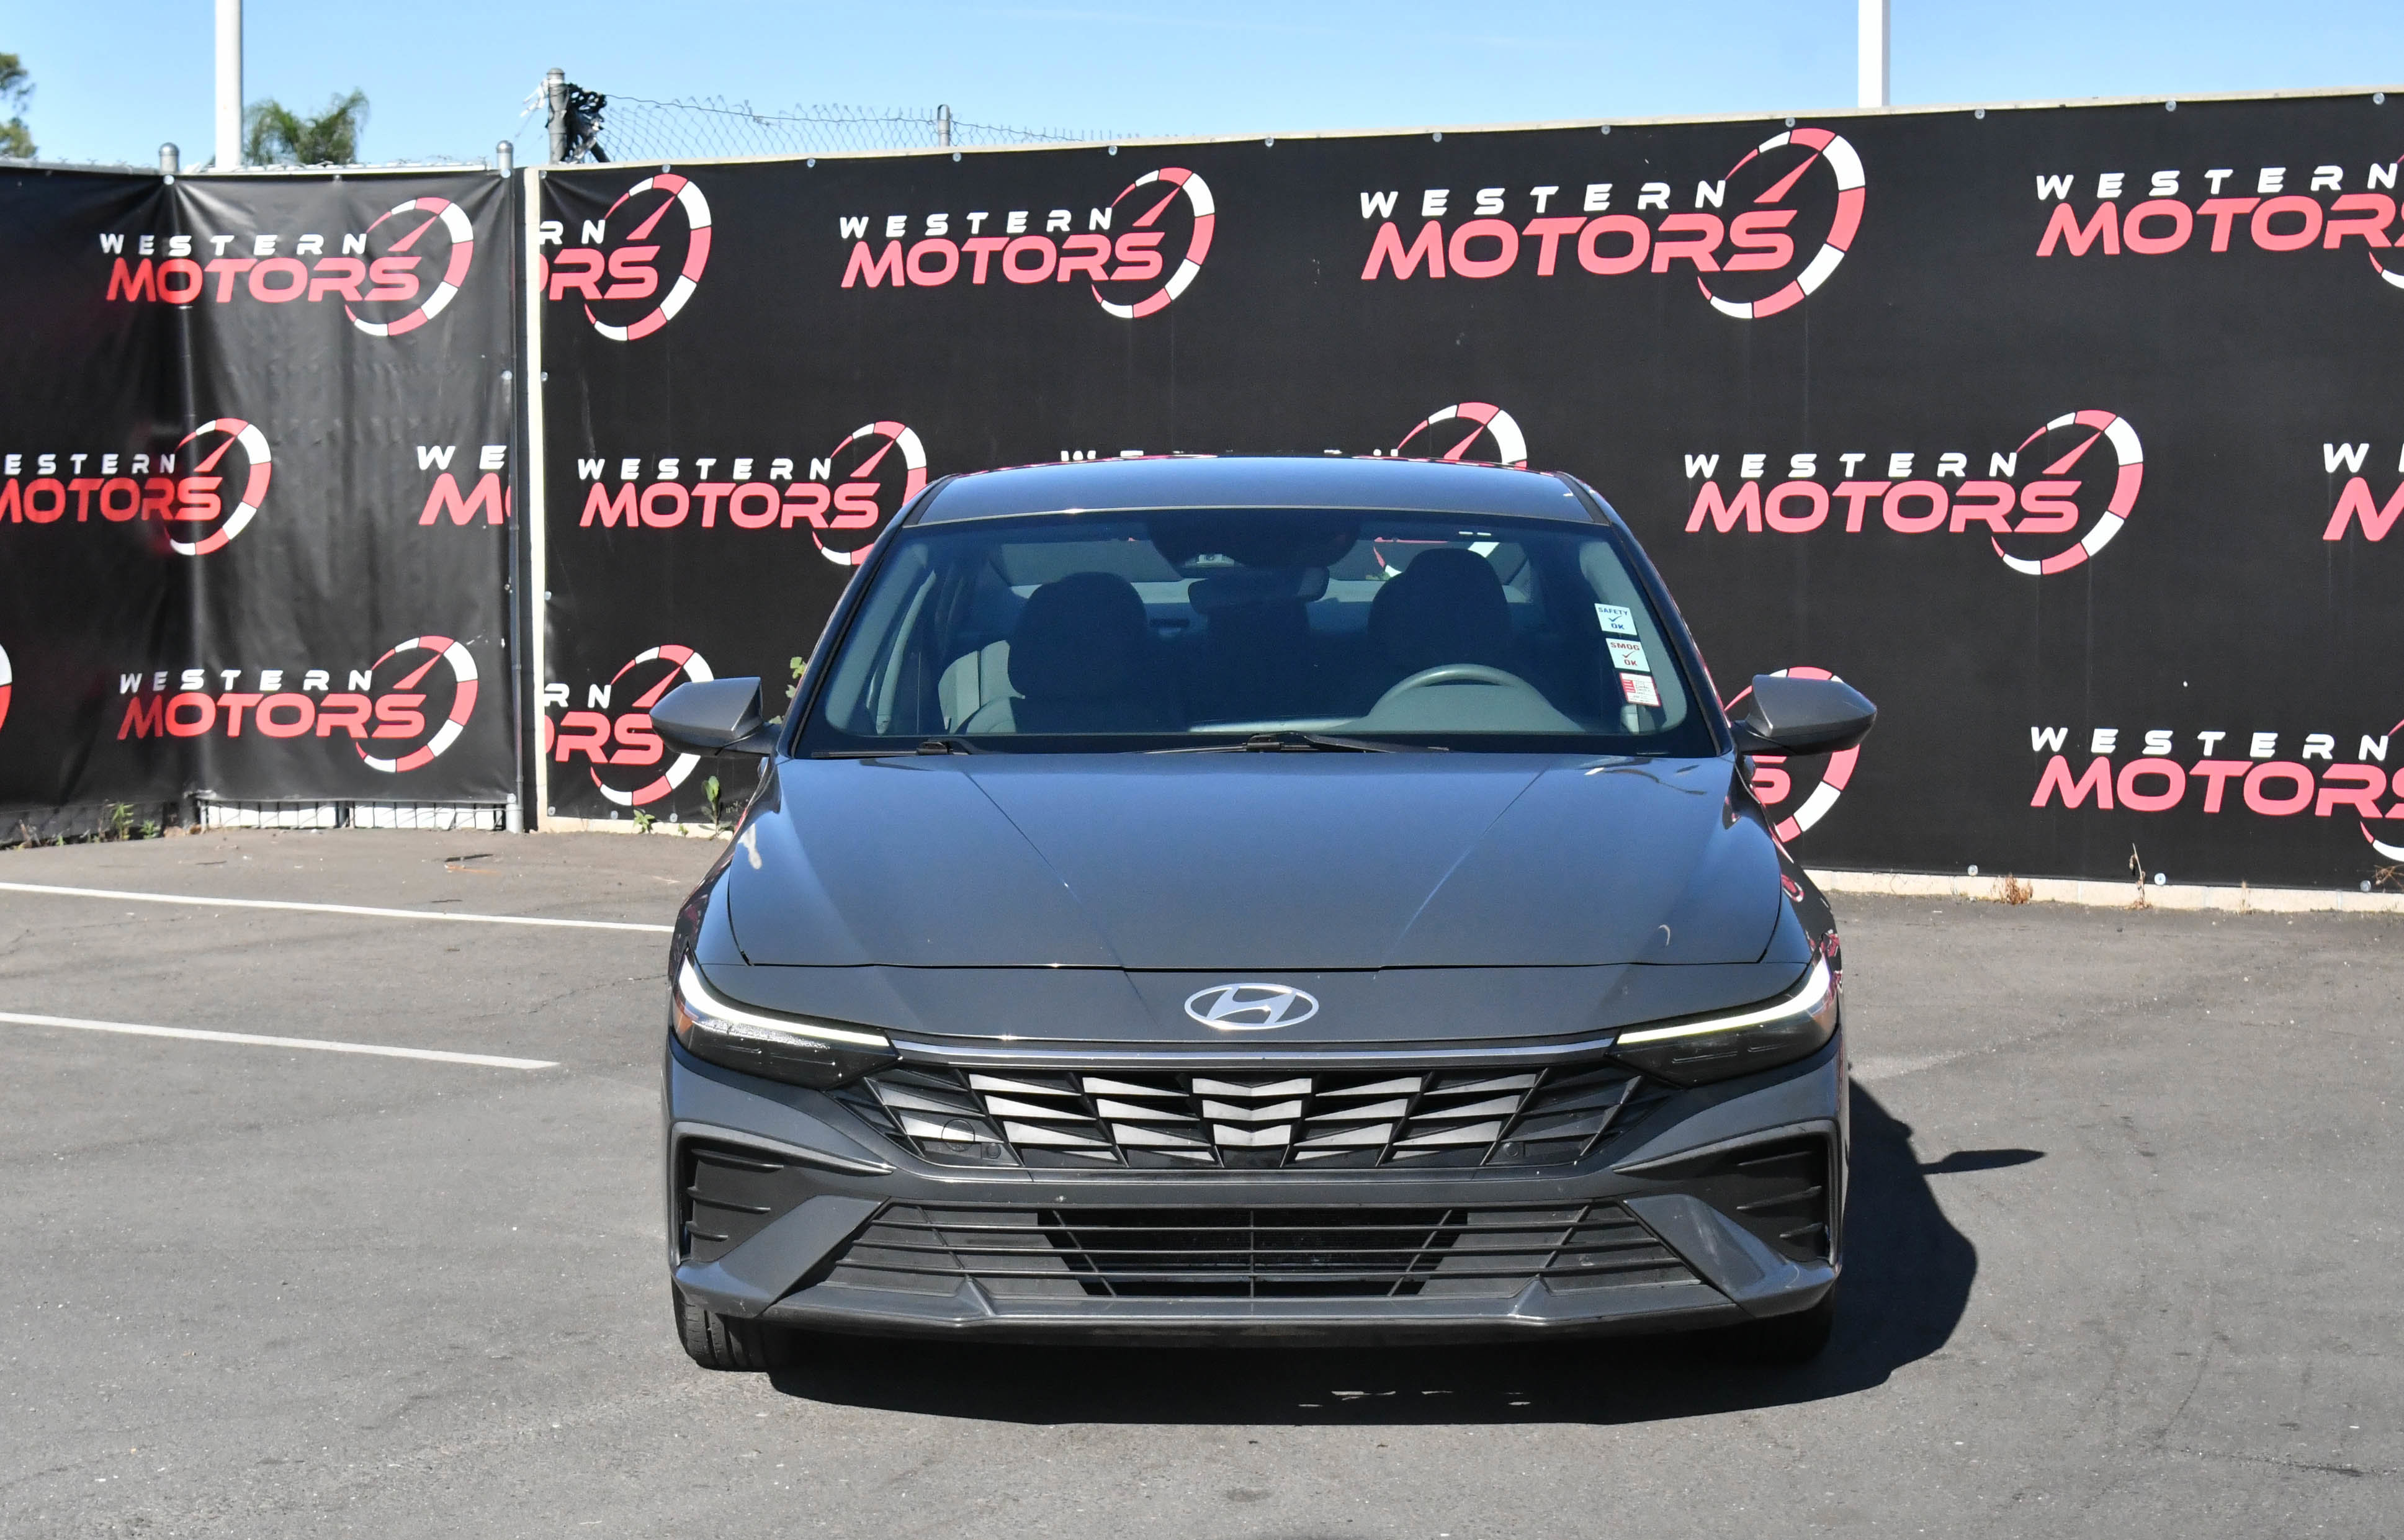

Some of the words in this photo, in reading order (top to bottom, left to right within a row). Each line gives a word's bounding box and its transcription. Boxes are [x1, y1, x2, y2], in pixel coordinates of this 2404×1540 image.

[1360, 179, 1726, 218] WESTERN
[2036, 163, 2398, 200] WESTERN
[840, 207, 1113, 240] WESTERN
[2036, 193, 2404, 256] MOTOR
[100, 233, 367, 256] WESTERN
[841, 232, 1165, 288] MOTORS
[1361, 210, 1798, 280] MOTORS
[106, 256, 421, 304] MOTORS
[540, 245, 660, 300] RS
[4, 454, 176, 475] ESTERN
[578, 458, 832, 480] WESTERN
[1684, 452, 2017, 478] WESTERN
[579, 482, 881, 529] MOTORS
[1685, 480, 2082, 534] MOTORS
[1598, 607, 1628, 616] SAFETY
[1610, 642, 1639, 651] SMOG
[119, 669, 372, 694] WESTERN
[117, 692, 426, 740] MOTORS
[544, 711, 664, 765] RS
[2031, 727, 2389, 761] WESTERN
[2030, 754, 2404, 819] MOTOR
